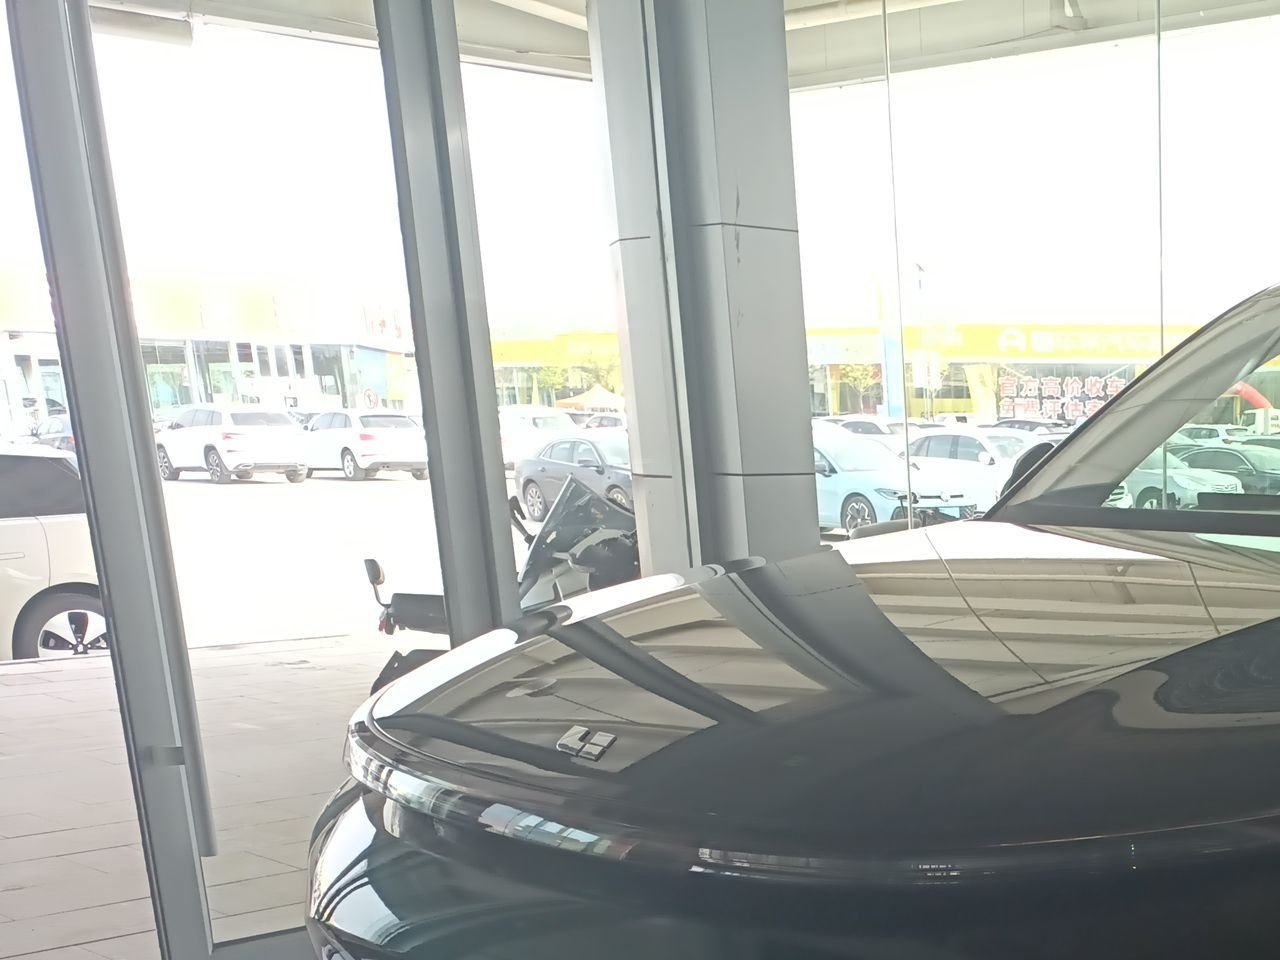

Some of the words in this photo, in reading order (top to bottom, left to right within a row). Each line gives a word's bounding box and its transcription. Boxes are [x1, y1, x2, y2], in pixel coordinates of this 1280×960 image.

[999, 376, 1126, 398] 官方高价收车
